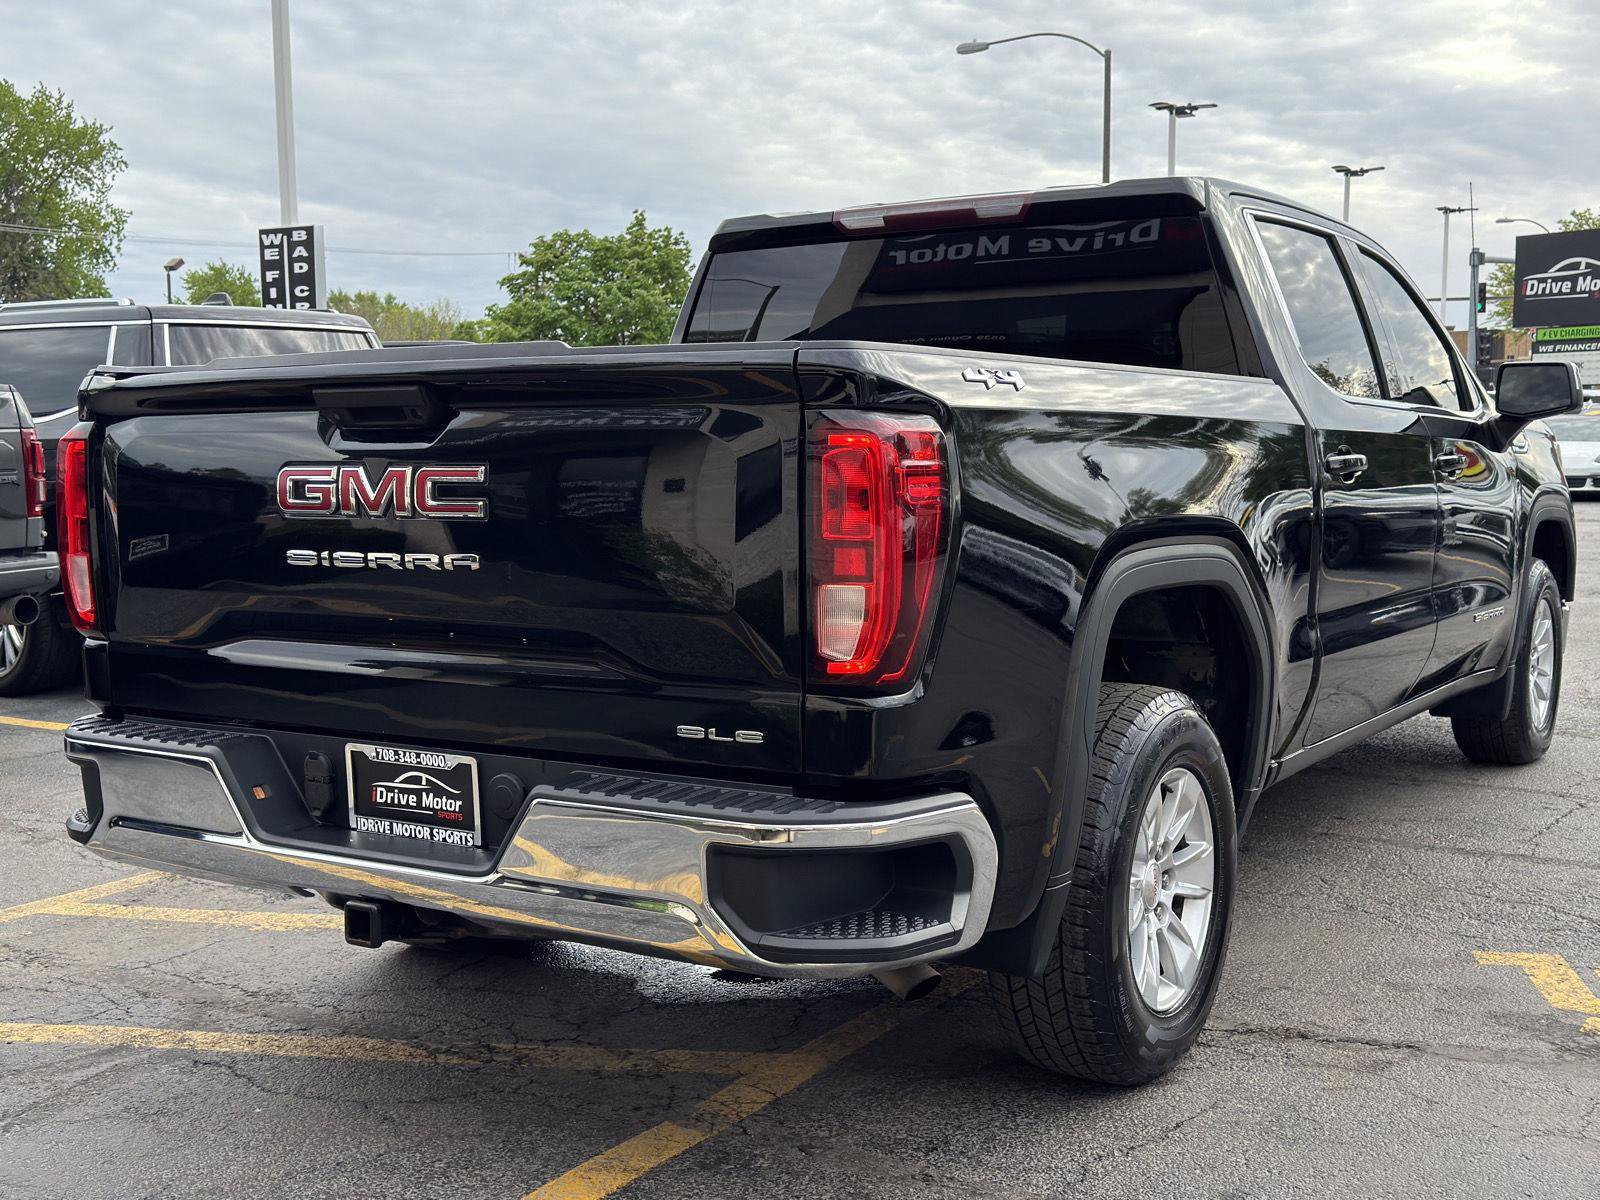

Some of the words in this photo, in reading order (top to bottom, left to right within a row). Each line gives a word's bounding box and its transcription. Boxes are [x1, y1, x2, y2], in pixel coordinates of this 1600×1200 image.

[292, 230, 309, 273] BAD
[1521, 278, 1571, 295] iDrive
[1548, 330, 1559, 338] EV
[1560, 328, 1600, 338] CHARGING
[1538, 345, 1554, 353] WE
[277, 465, 487, 519] GMC
[286, 549, 481, 571] SIERRA
[677, 725, 764, 743] SLE
[376, 748, 445, 767] 708-348-0000
[371, 787, 417, 806] iDrive
[422, 791, 462, 812] Motor
[437, 811, 463, 821] SPORTS
[393, 822, 431, 840] MOTOR
[433, 828, 474, 847] SPORTS
